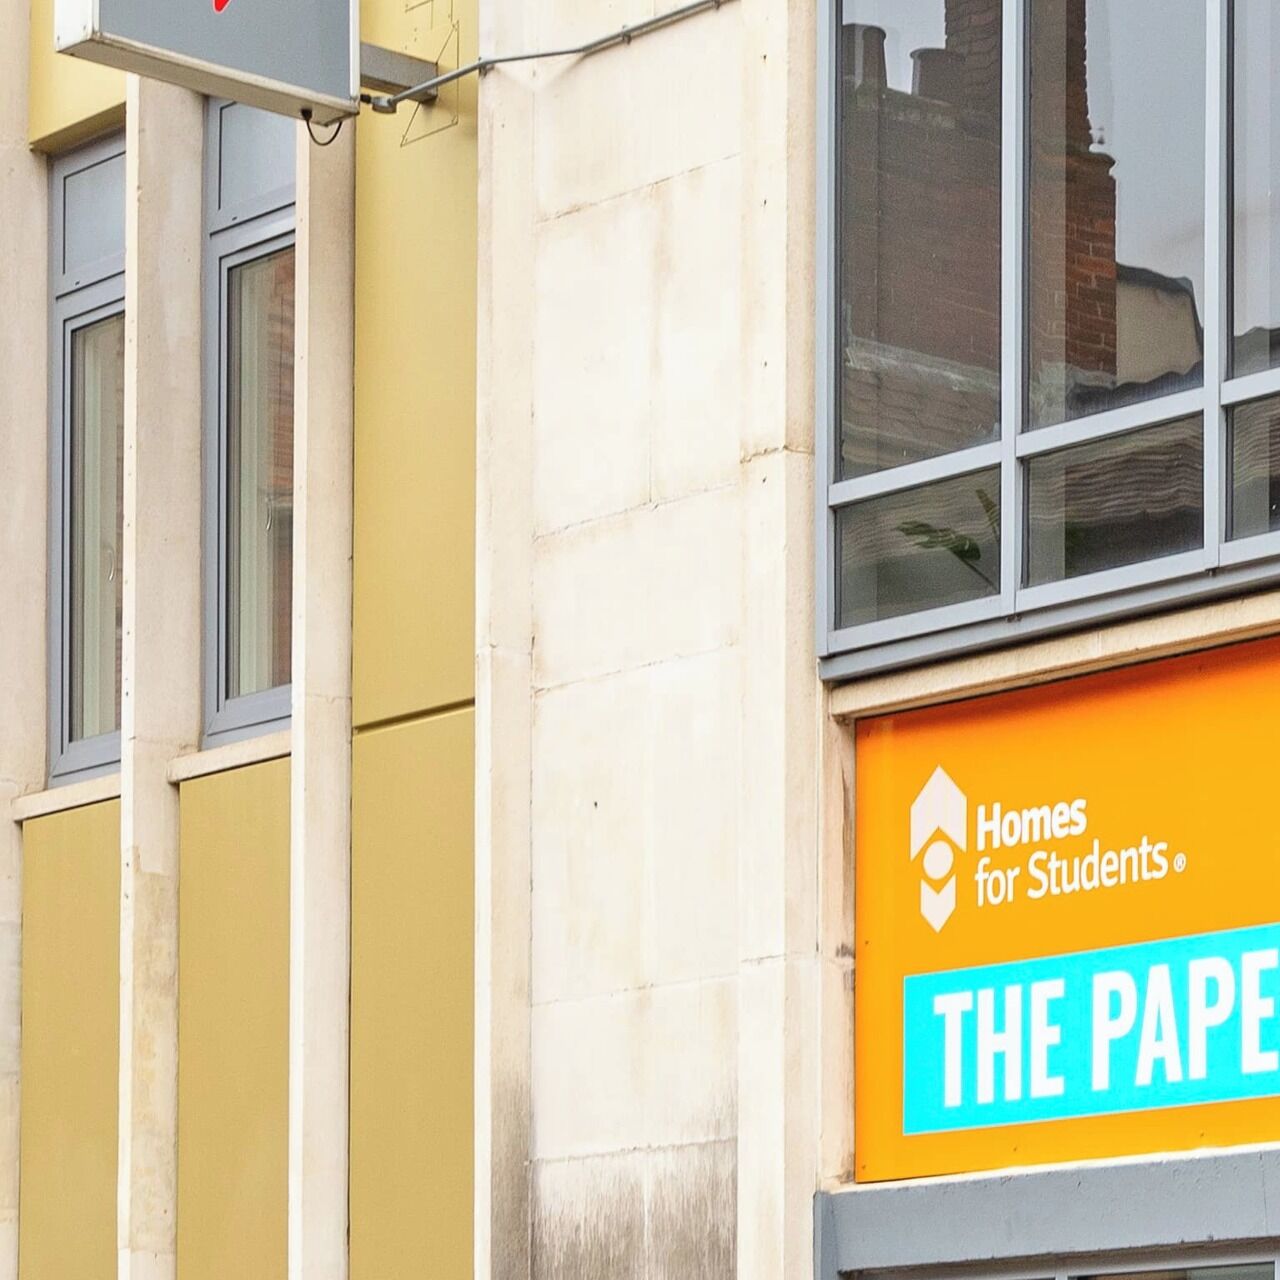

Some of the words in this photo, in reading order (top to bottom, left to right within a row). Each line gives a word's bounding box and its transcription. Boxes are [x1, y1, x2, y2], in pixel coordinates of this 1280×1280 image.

[976, 797, 1087, 853] Homes
[975, 854, 1017, 907] for
[933, 978, 1065, 1109] THE
